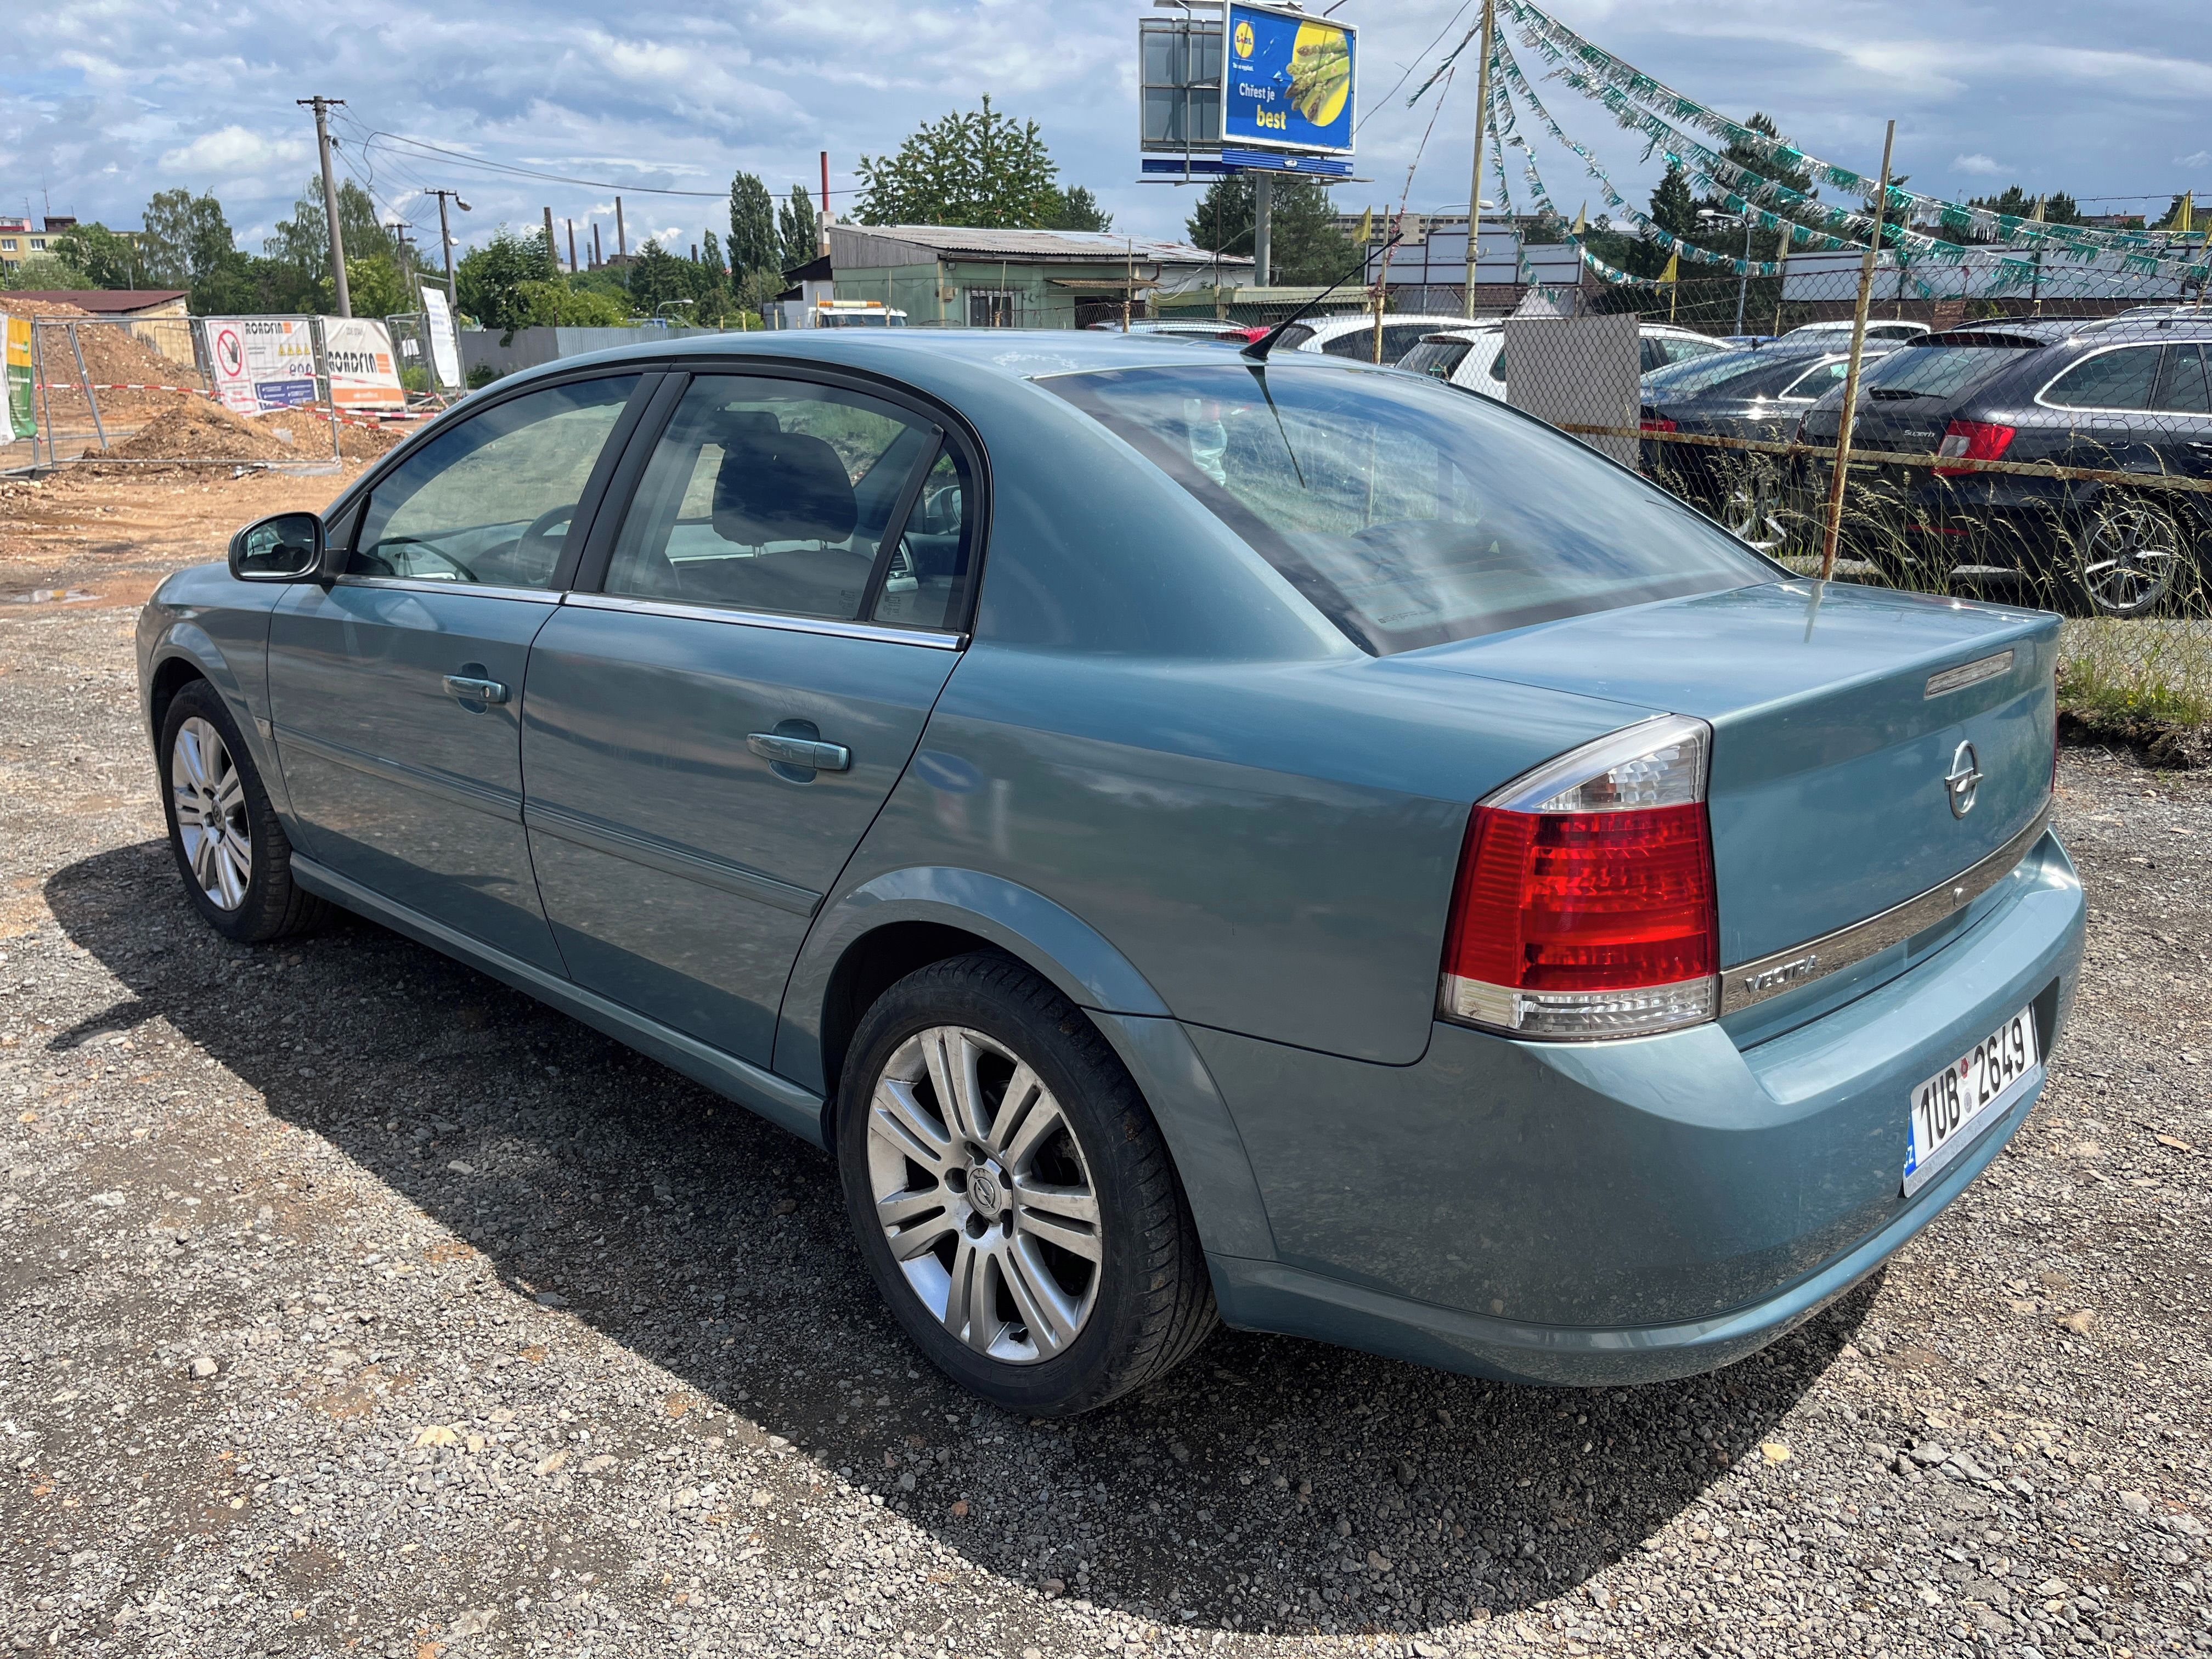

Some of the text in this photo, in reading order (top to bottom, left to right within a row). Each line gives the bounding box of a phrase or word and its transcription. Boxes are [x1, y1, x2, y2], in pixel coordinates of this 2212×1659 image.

[1239, 82, 1275, 103] Chřest je
[1256, 104, 1286, 130] best
[1745, 955, 1818, 994] VECTRA
[1920, 1017, 2025, 1150] 1UB 2649
